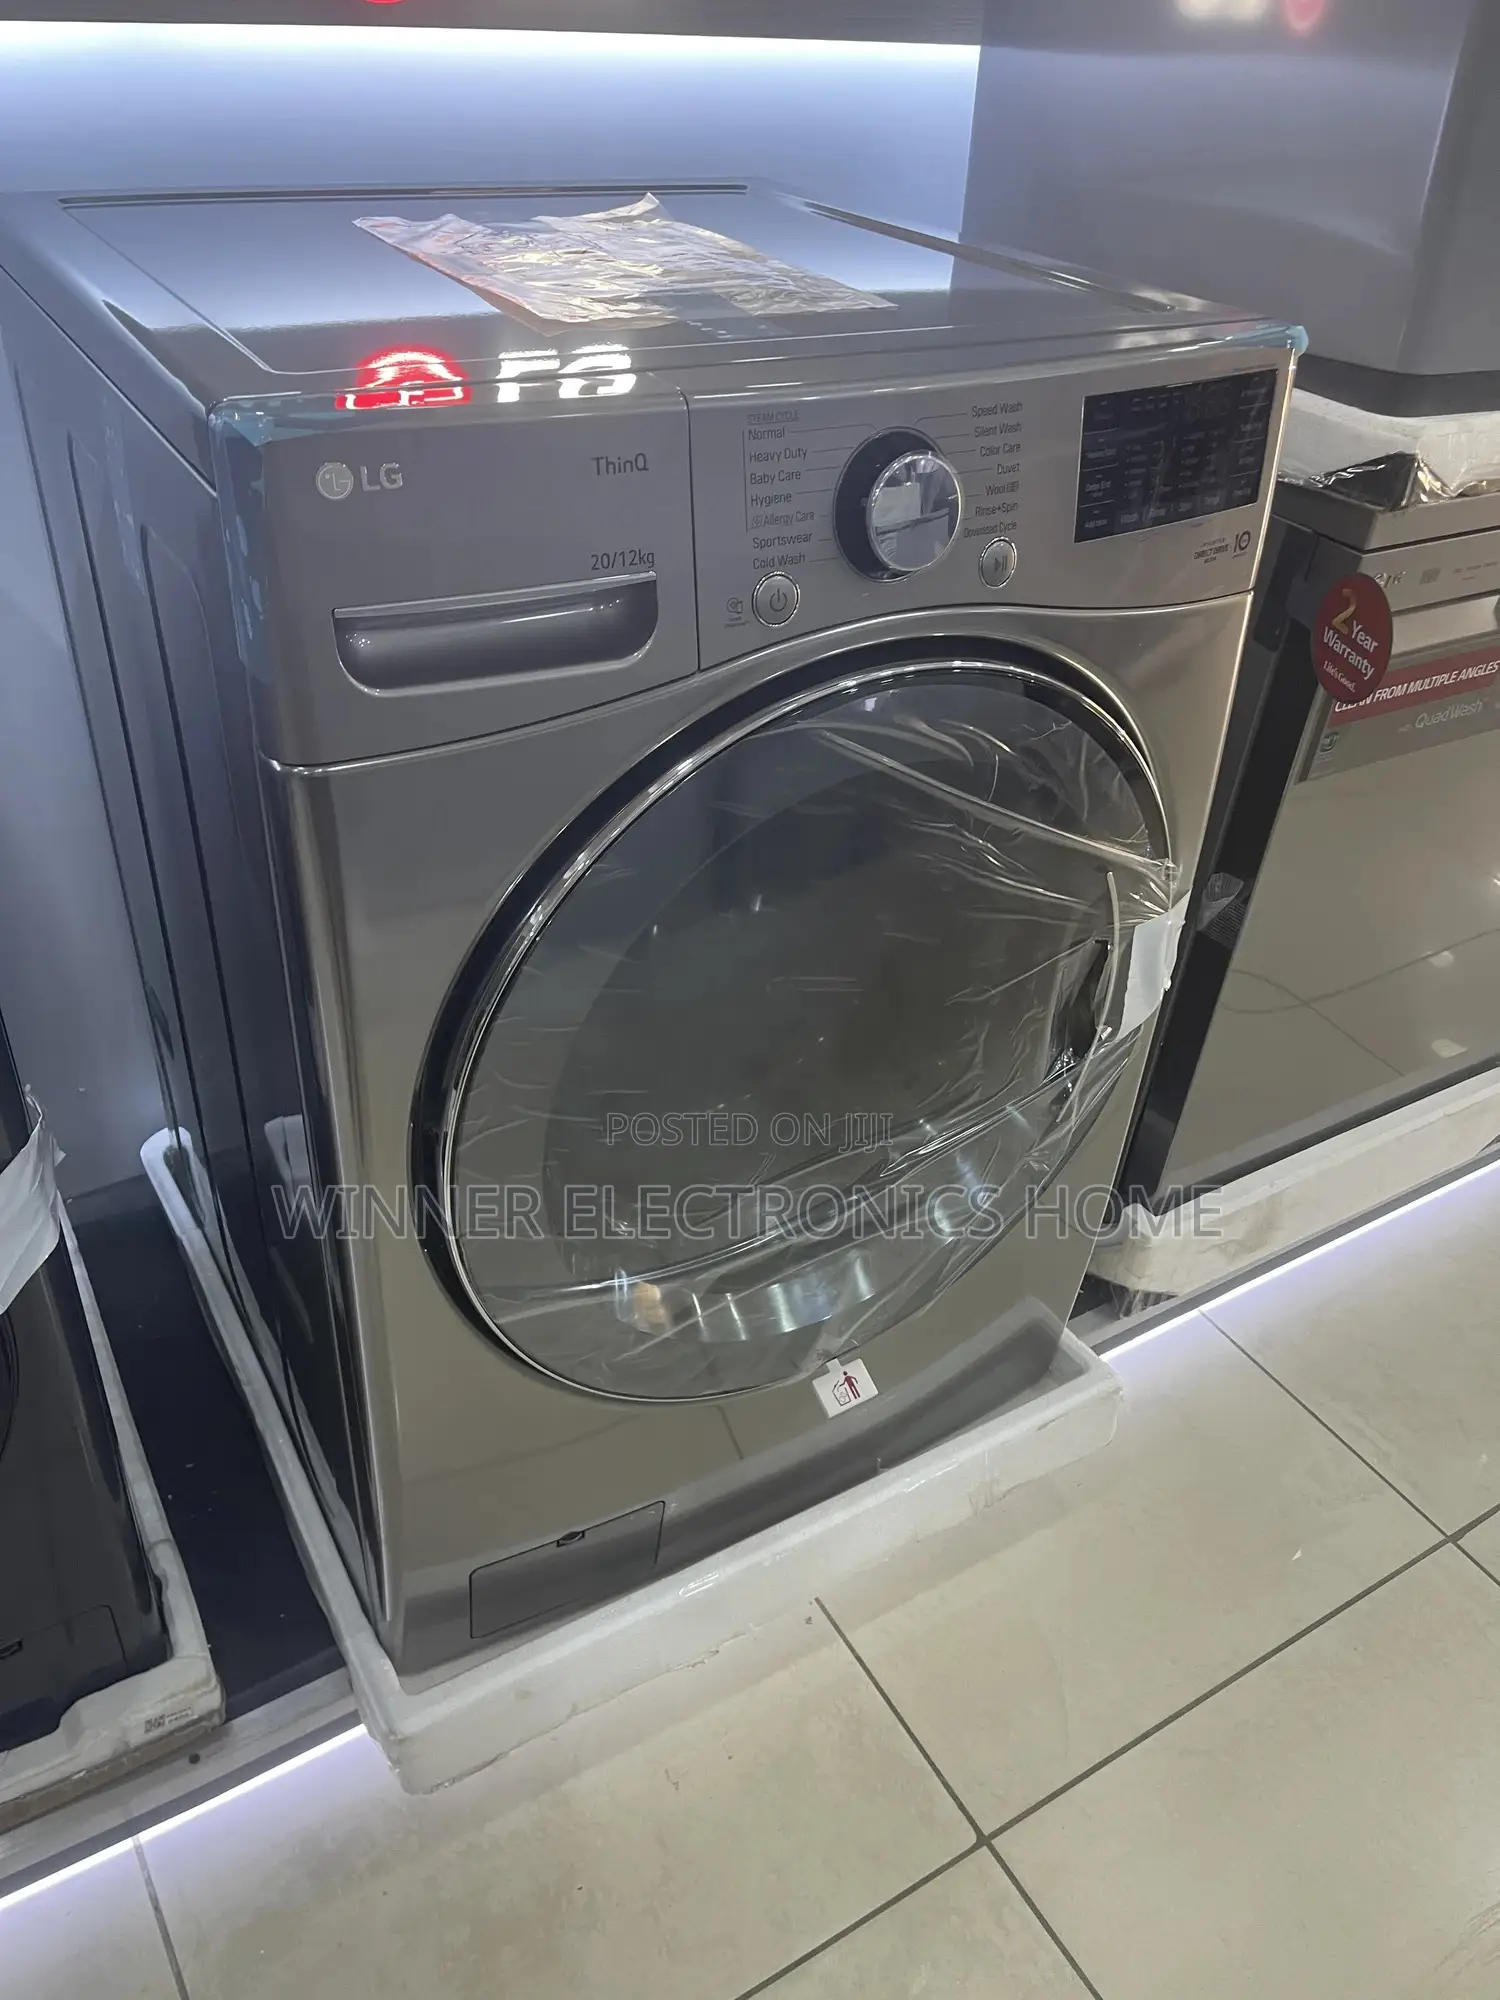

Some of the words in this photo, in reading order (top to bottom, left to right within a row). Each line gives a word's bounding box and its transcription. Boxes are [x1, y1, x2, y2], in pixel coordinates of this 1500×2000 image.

[972, 404, 998, 419] Speed
[1000, 401, 1023, 414] Wash
[748, 426, 785, 441] Normal
[999, 421, 1022, 434] Wash
[749, 451, 782, 462] Heavy
[784, 447, 808, 460] Duty
[980, 445, 1001, 457] Color
[1003, 442, 1021, 454] Care
[591, 453, 649, 477] ThinQ
[997, 462, 1020, 475] Duvet
[359, 463, 404, 493] LG
[750, 471, 776, 485] Baby
[778, 469, 801, 482] Care
[750, 493, 792, 508] Hygiene
[763, 513, 794, 527] Allergy
[795, 511, 815, 522] Care
[752, 533, 813, 549] Sportswear
[591, 549, 656, 571] 20/12kg
[752, 556, 775, 570] Cold
[778, 553, 806, 567] Wash
[1331, 588, 1357, 635] 2
[1351, 620, 1379, 653] Year
[1323, 626, 1376, 681] Warranty
[1373, 682, 1409, 704] FROM
[1407, 671, 1458, 695] MULTIPLE
[1457, 660, 1500, 683] ANGLES
